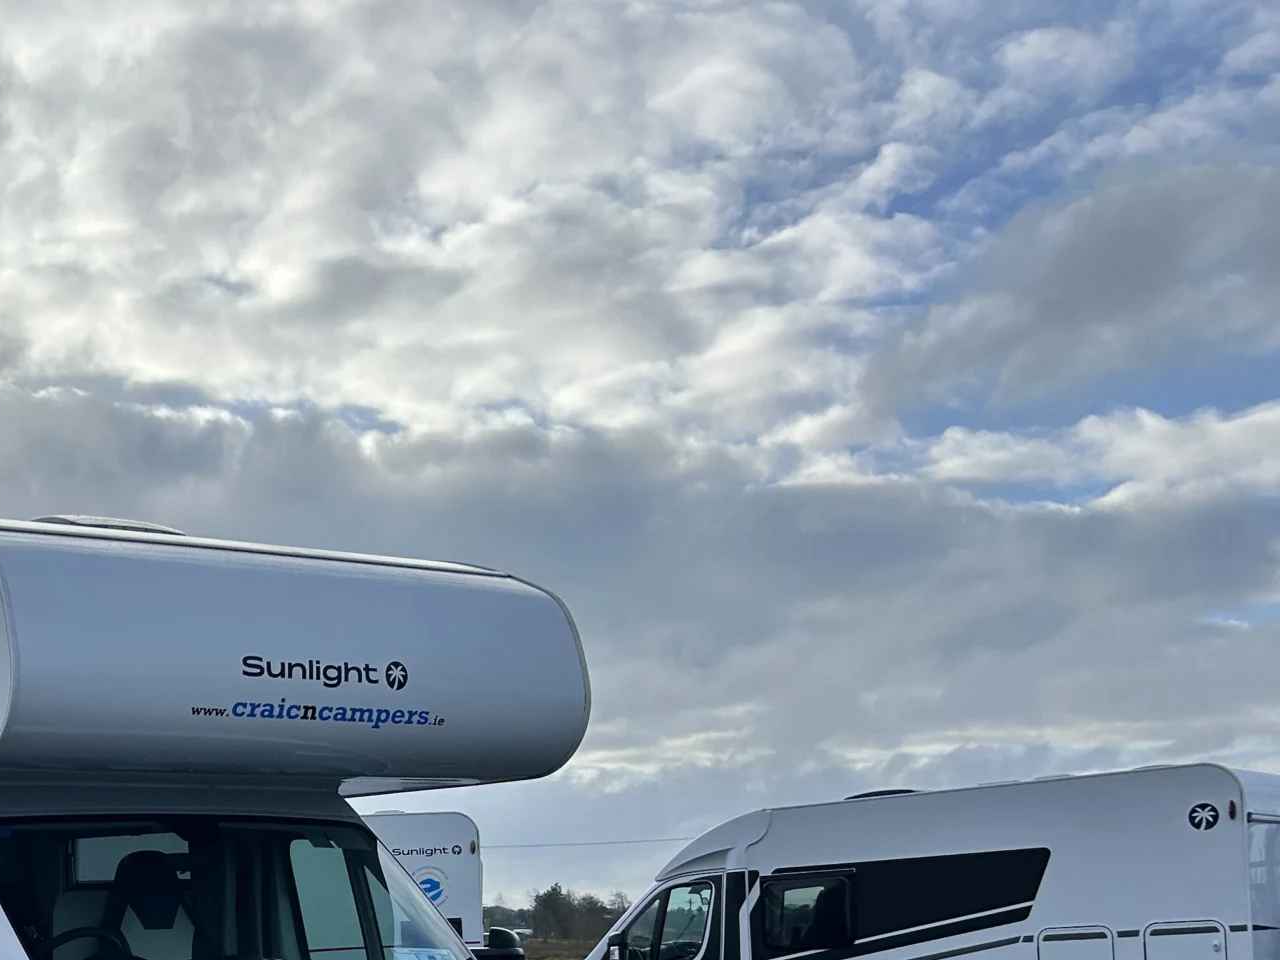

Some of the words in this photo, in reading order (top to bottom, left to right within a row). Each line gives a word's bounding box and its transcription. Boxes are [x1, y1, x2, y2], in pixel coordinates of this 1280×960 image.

[242, 655, 379, 688] Sunlight
[191, 698, 445, 729] www.craicncampers.ie
[391, 847, 449, 857] Sunlight
